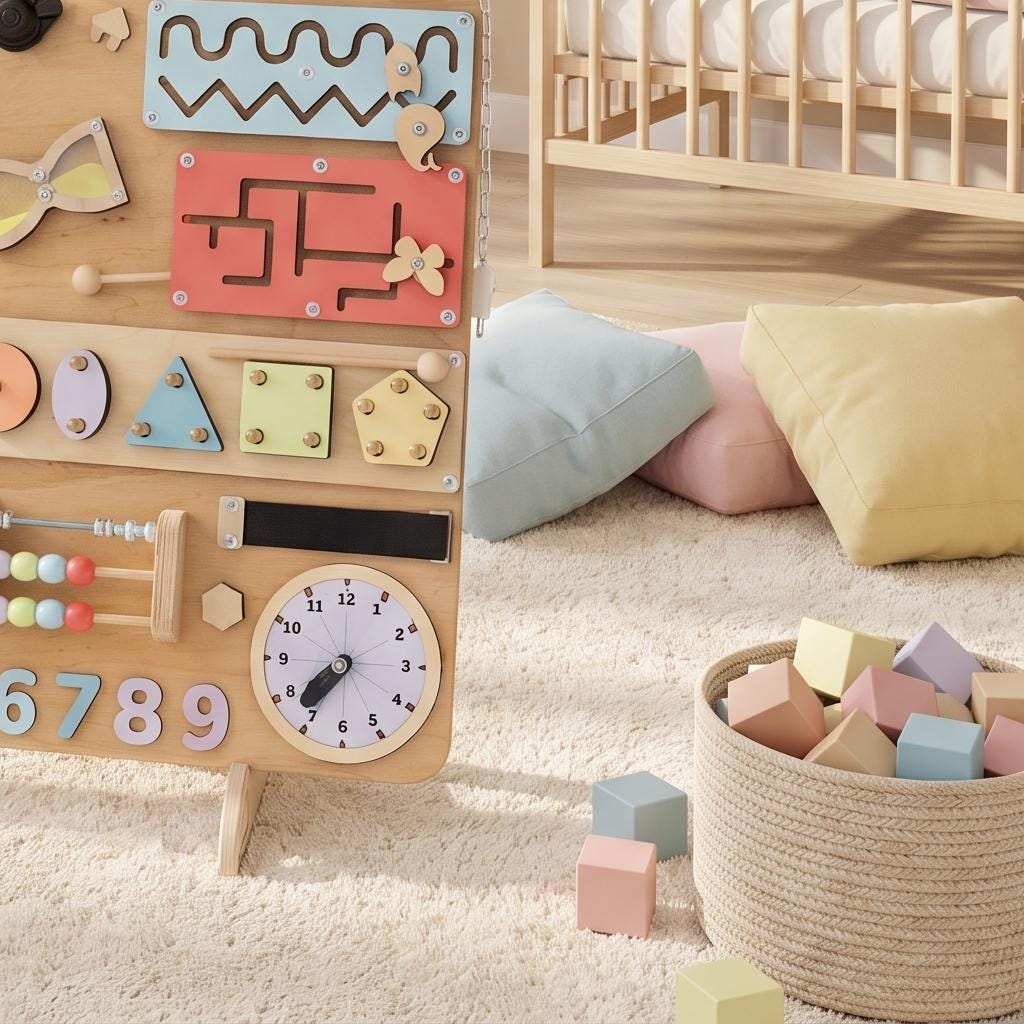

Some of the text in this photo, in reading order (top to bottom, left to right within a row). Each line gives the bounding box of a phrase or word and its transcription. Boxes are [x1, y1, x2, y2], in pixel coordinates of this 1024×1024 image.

[307, 599, 323, 612] 11
[337, 593, 355, 606] 12
[372, 603, 381, 615] 1
[283, 621, 301, 634] 10
[395, 628, 404, 641] 2
[278, 652, 289, 665] 9
[401, 660, 410, 673] 3
[286, 685, 295, 698] 8
[391, 693, 402, 706] 4
[55, 672, 102, 739] 7
[113, 677, 163, 745] 8
[182, 683, 230, 751] 9
[308, 710, 317, 722] 7
[368, 713, 378, 726] 5
[338, 720, 348, 733] 6
